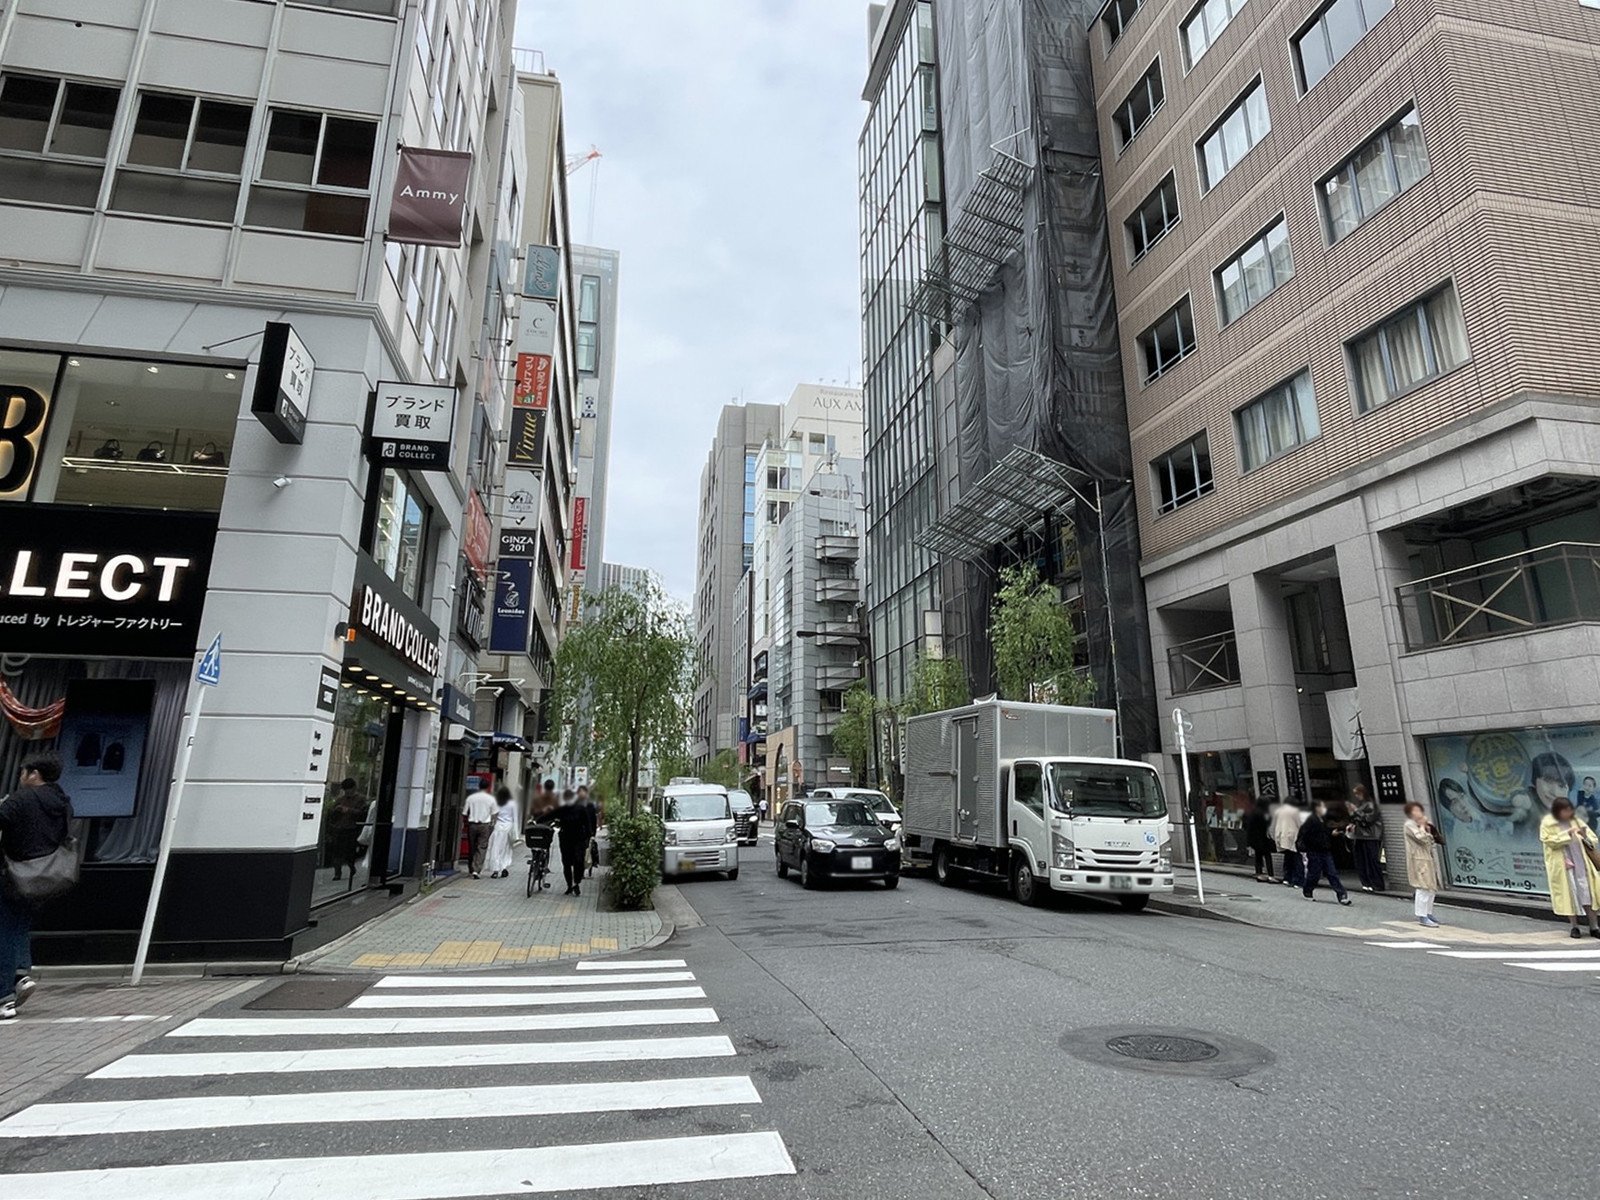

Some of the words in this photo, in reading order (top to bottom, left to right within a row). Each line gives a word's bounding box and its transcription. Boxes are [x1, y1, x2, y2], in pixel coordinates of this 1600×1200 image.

[400, 185, 459, 205] Ammy
[385, 394, 445, 413] ブランド
[812, 396, 841, 410] AUX
[394, 413, 432, 430] 買取
[515, 411, 538, 461] Virtue
[398, 451, 437, 461] COLLECT
[399, 444, 430, 453] BRAND
[501, 535, 534, 545] GINZA
[509, 544, 526, 552] 201
[0, 550, 190, 603] LECT
[34, 614, 50, 628] by
[57, 614, 183, 630] トレジャーファクトリー
[361, 585, 406, 650] BRAND
[404, 622, 444, 678] COLLECT
